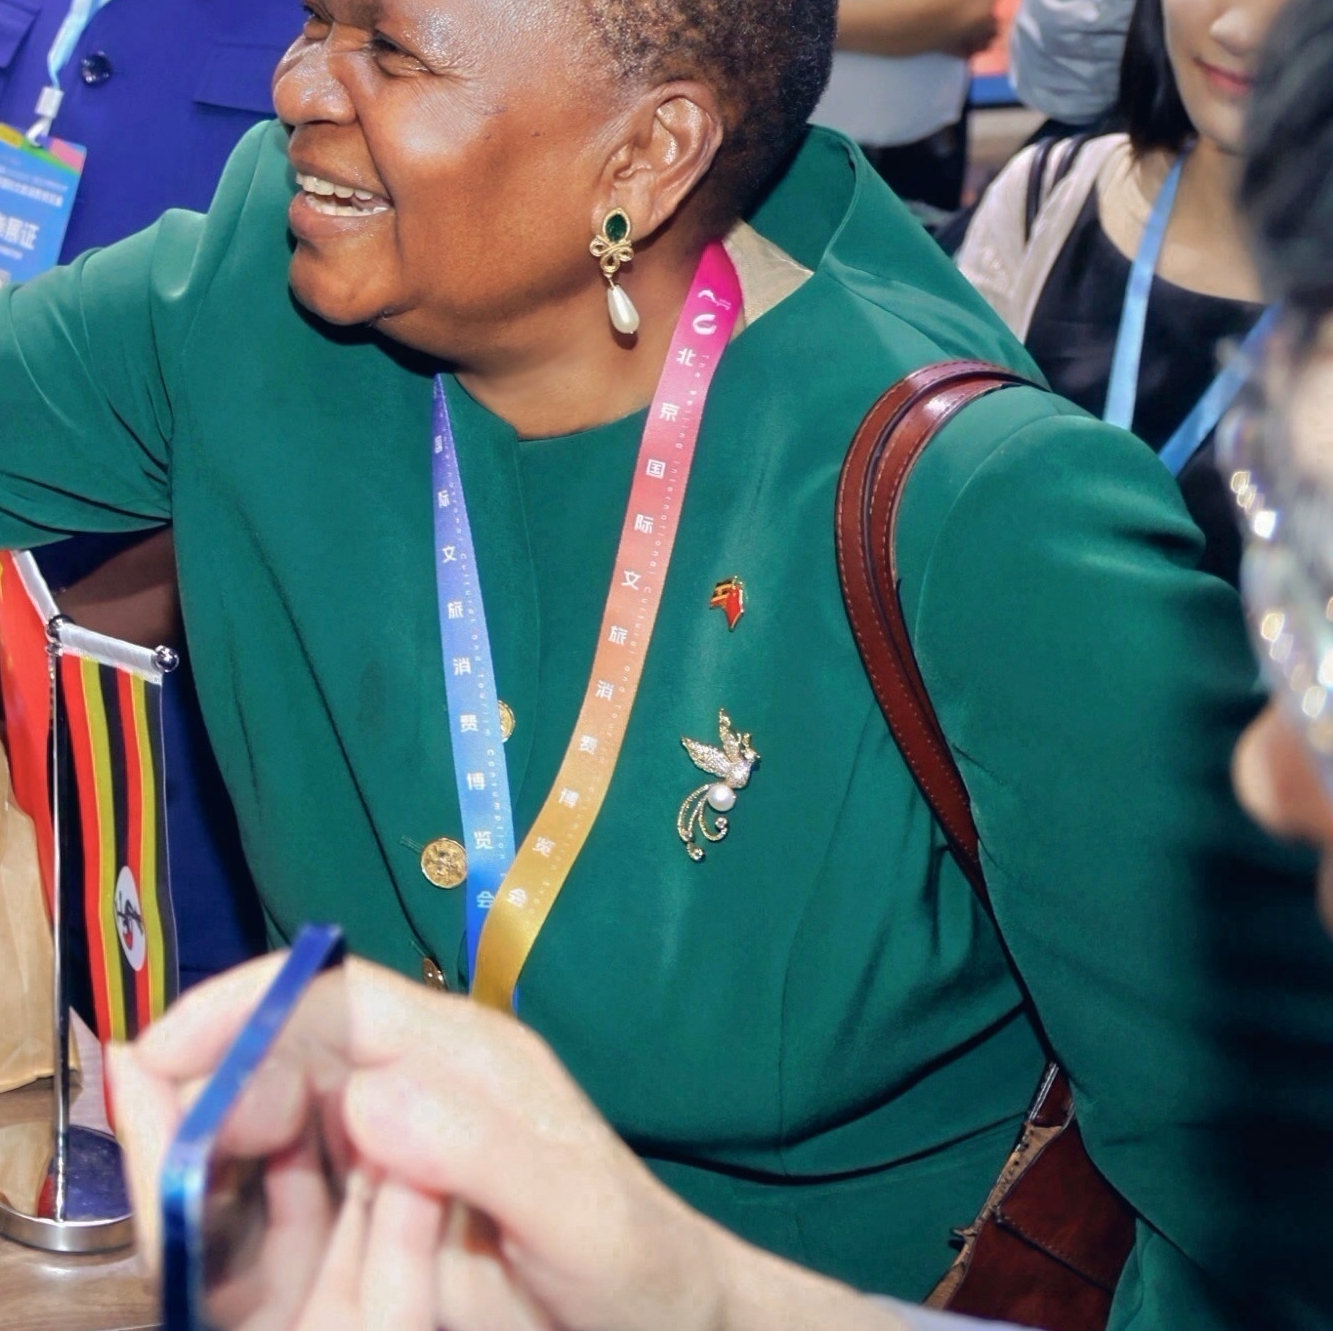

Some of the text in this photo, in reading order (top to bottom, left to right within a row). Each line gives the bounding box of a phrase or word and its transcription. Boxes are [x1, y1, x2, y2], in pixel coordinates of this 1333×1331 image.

[675, 390, 698, 450] Beijing
[648, 460, 681, 576] International
[434, 381, 494, 908] 国际文旅消费博览会
[628, 585, 653, 655] Cultural
[618, 664, 631, 694] and
